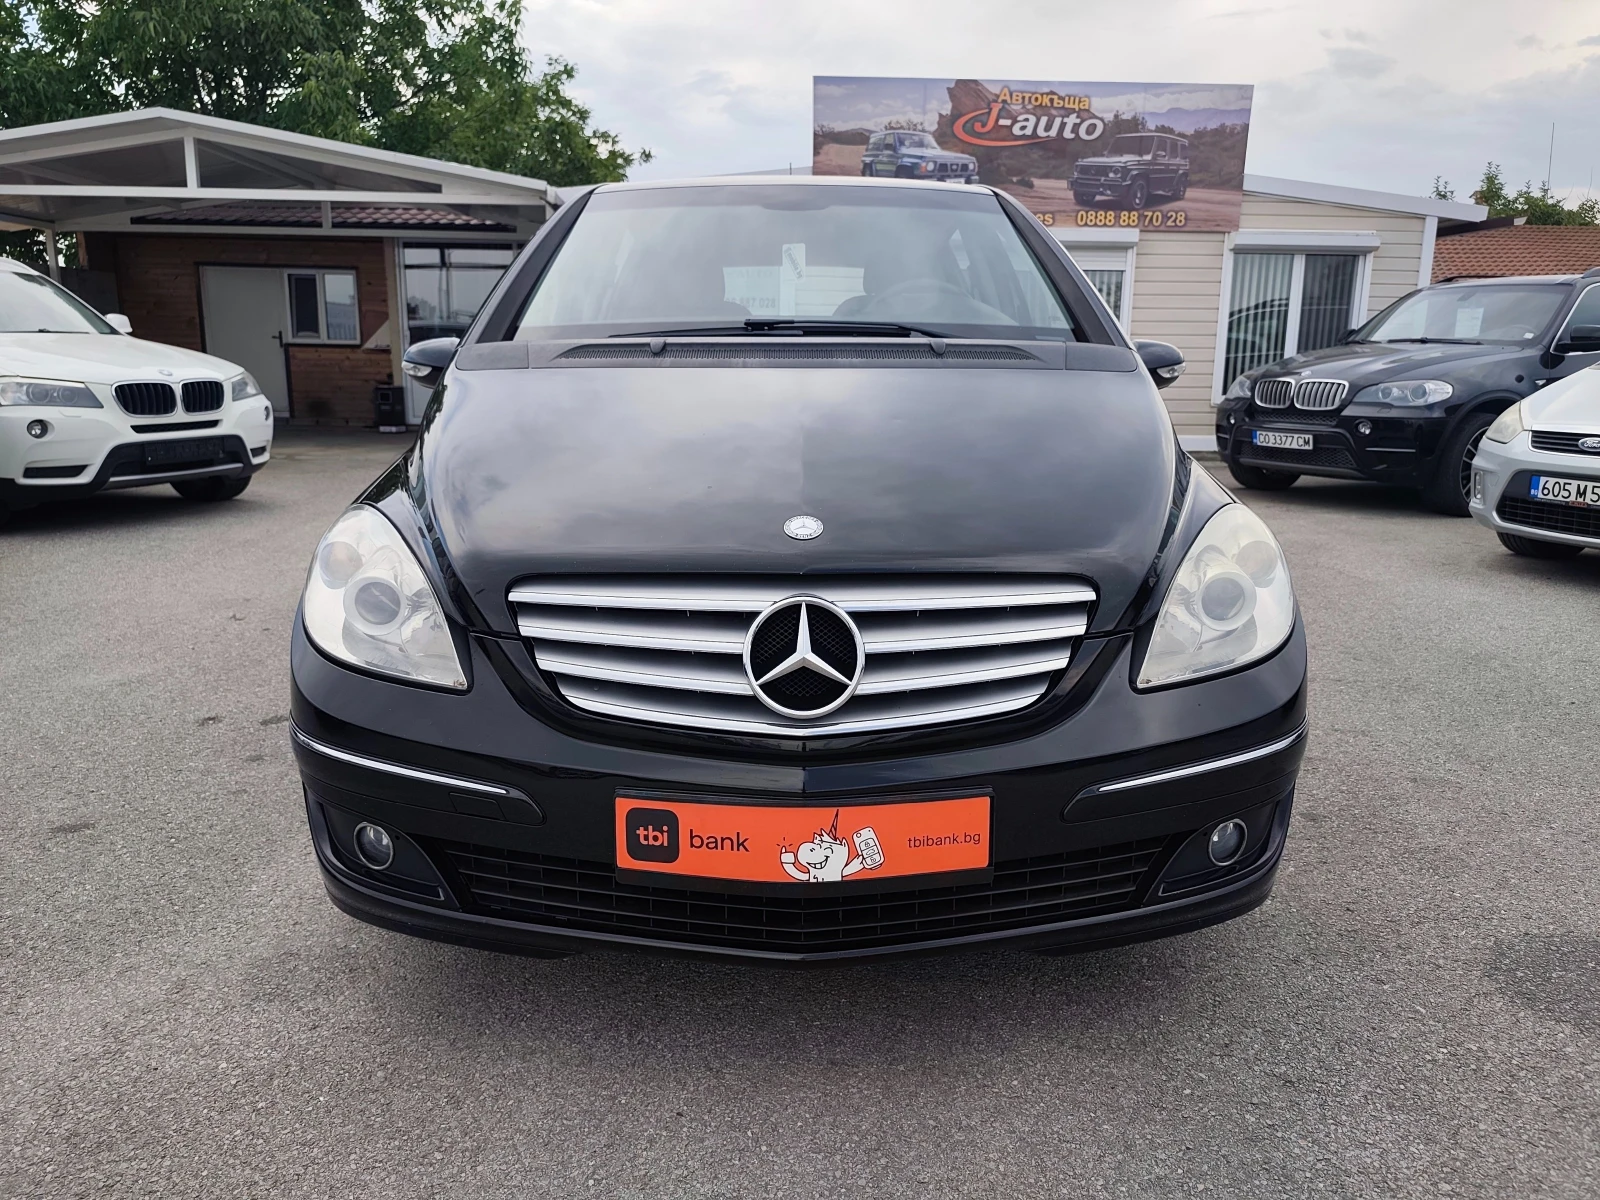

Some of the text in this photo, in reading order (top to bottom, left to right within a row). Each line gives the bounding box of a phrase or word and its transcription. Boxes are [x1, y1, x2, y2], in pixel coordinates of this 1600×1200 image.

[997, 87, 1090, 111] Автокъща
[973, 103, 1104, 141] J-auto
[1076, 211, 1115, 226] 0888
[1119, 211, 1139, 226] 88
[1143, 211, 1162, 226] 70
[1166, 211, 1186, 226] 28
[1258, 432, 1270, 444] CO
[1271, 434, 1295, 446] 3377
[1296, 436, 1311, 448] CM
[1541, 479, 1572, 500] 605
[635, 825, 750, 853] tbi bank
[907, 831, 981, 849] tbibank.bg
